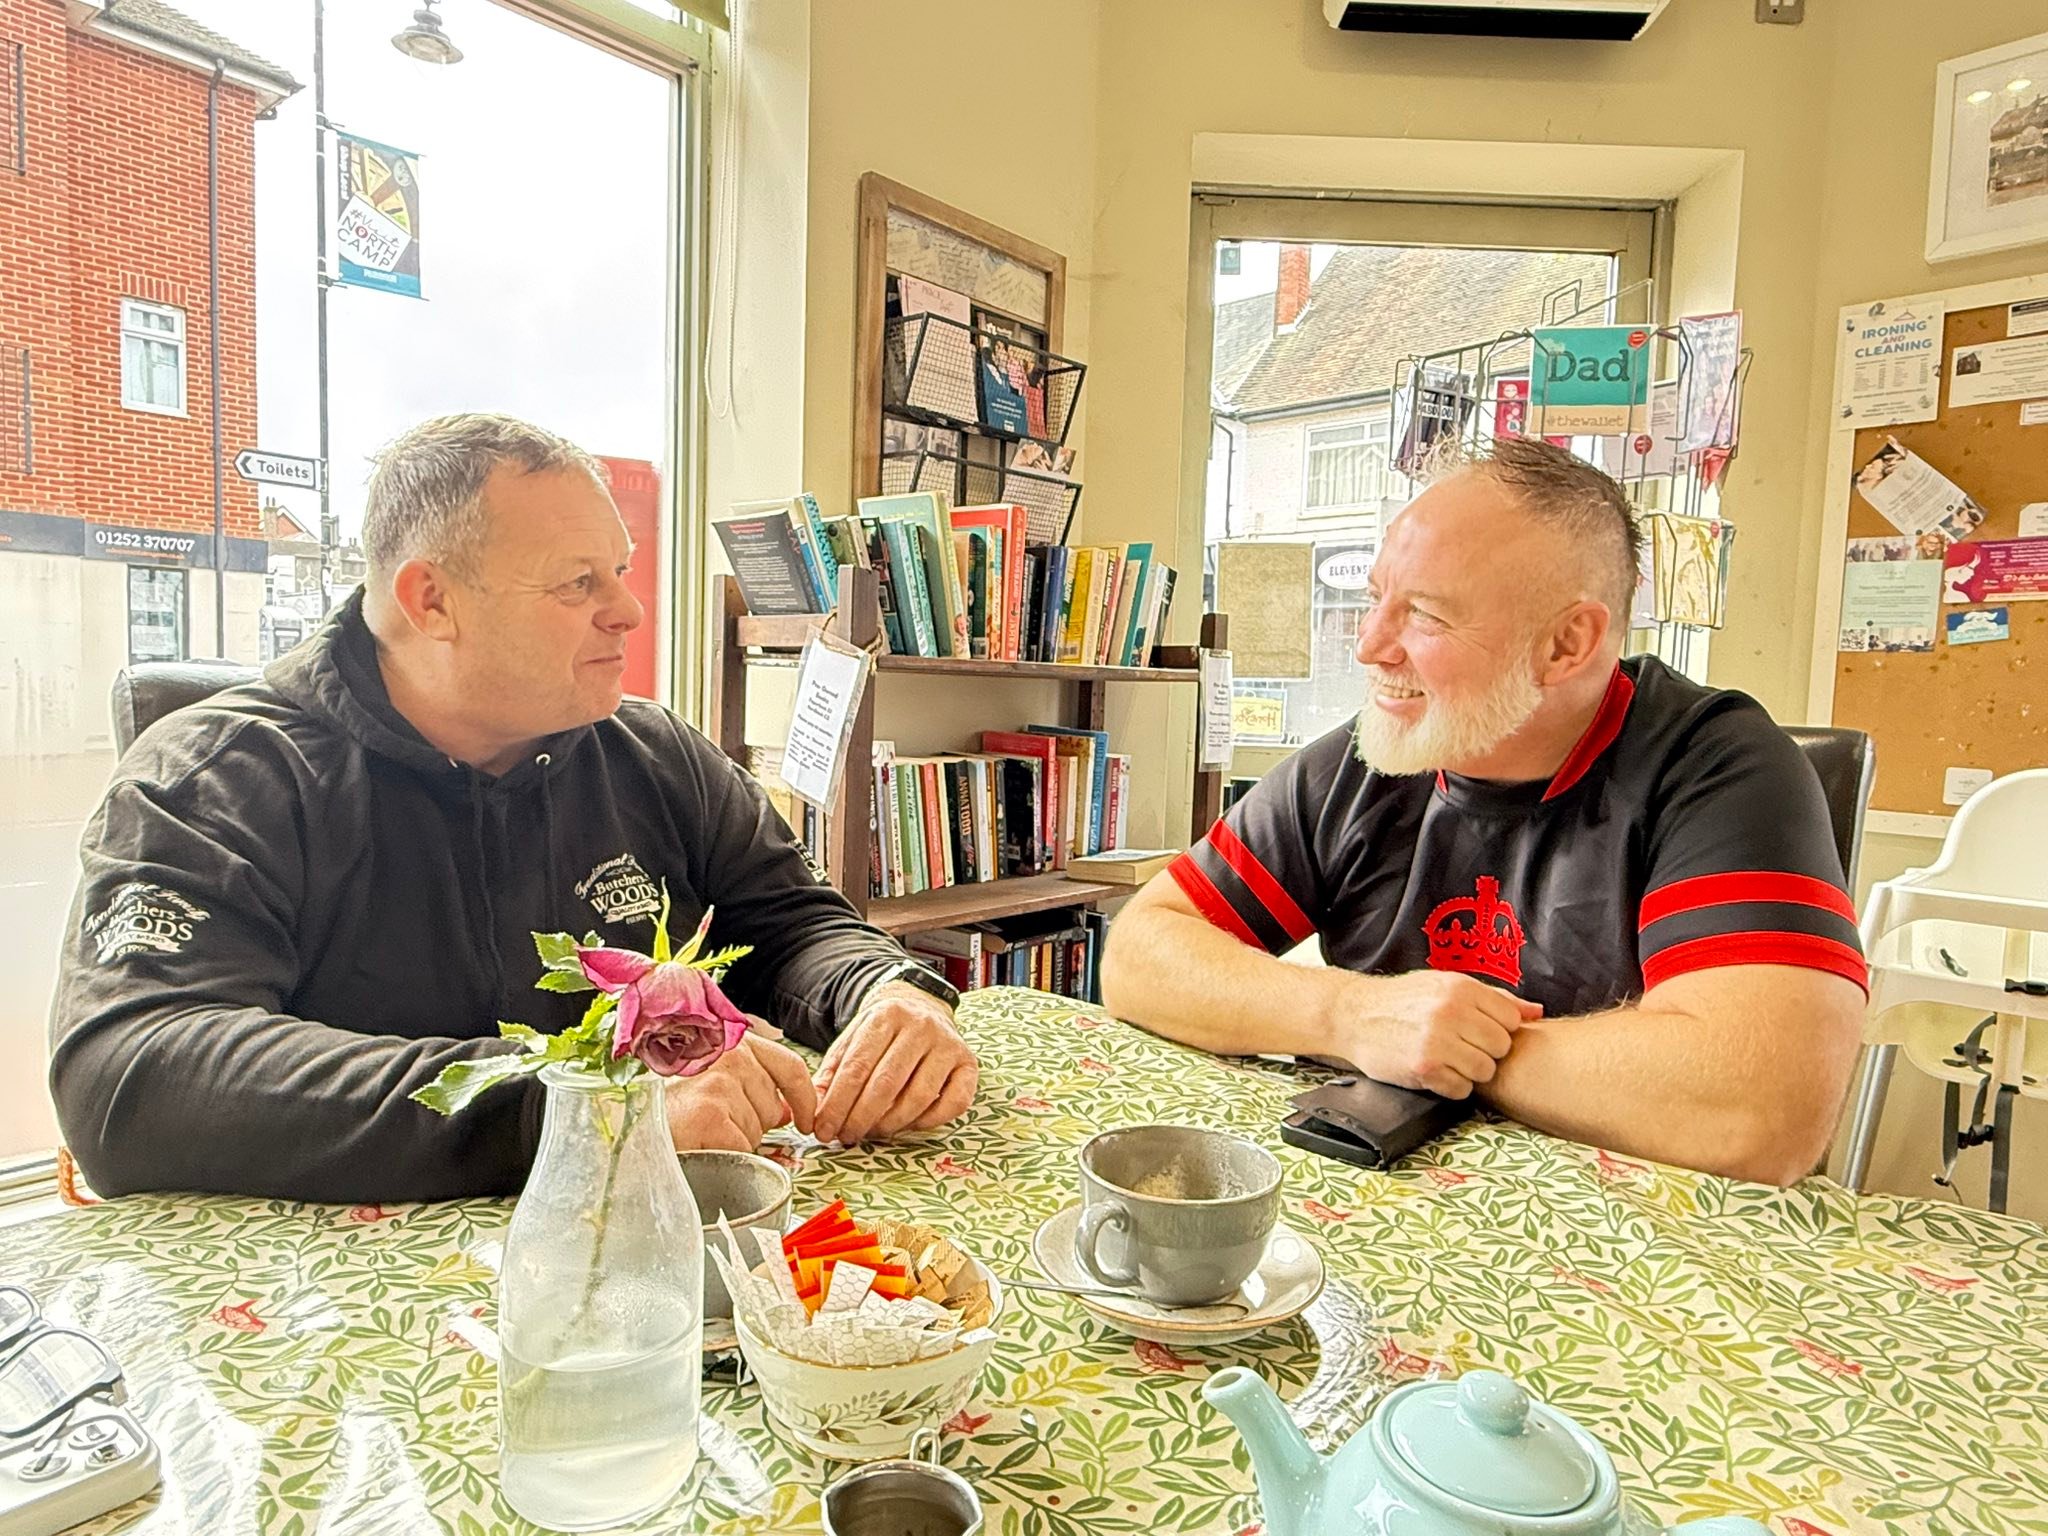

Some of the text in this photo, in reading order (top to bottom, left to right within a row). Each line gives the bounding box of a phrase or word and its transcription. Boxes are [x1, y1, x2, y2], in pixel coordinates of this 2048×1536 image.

[337, 228, 391, 269] CAMP
[341, 216, 398, 261] NORTH
[1862, 321, 1927, 339] IRONING
[1881, 335, 1906, 345] AND
[1855, 339, 1932, 358] CLEANING
[1547, 349, 1630, 382] Dad
[1547, 414, 1625, 428] #thewallet
[257, 459, 309, 479] Toilets
[95, 530, 195, 553] 01252 370707
[590, 883, 660, 915] WOODS
[94, 915, 193, 954] WOODS
